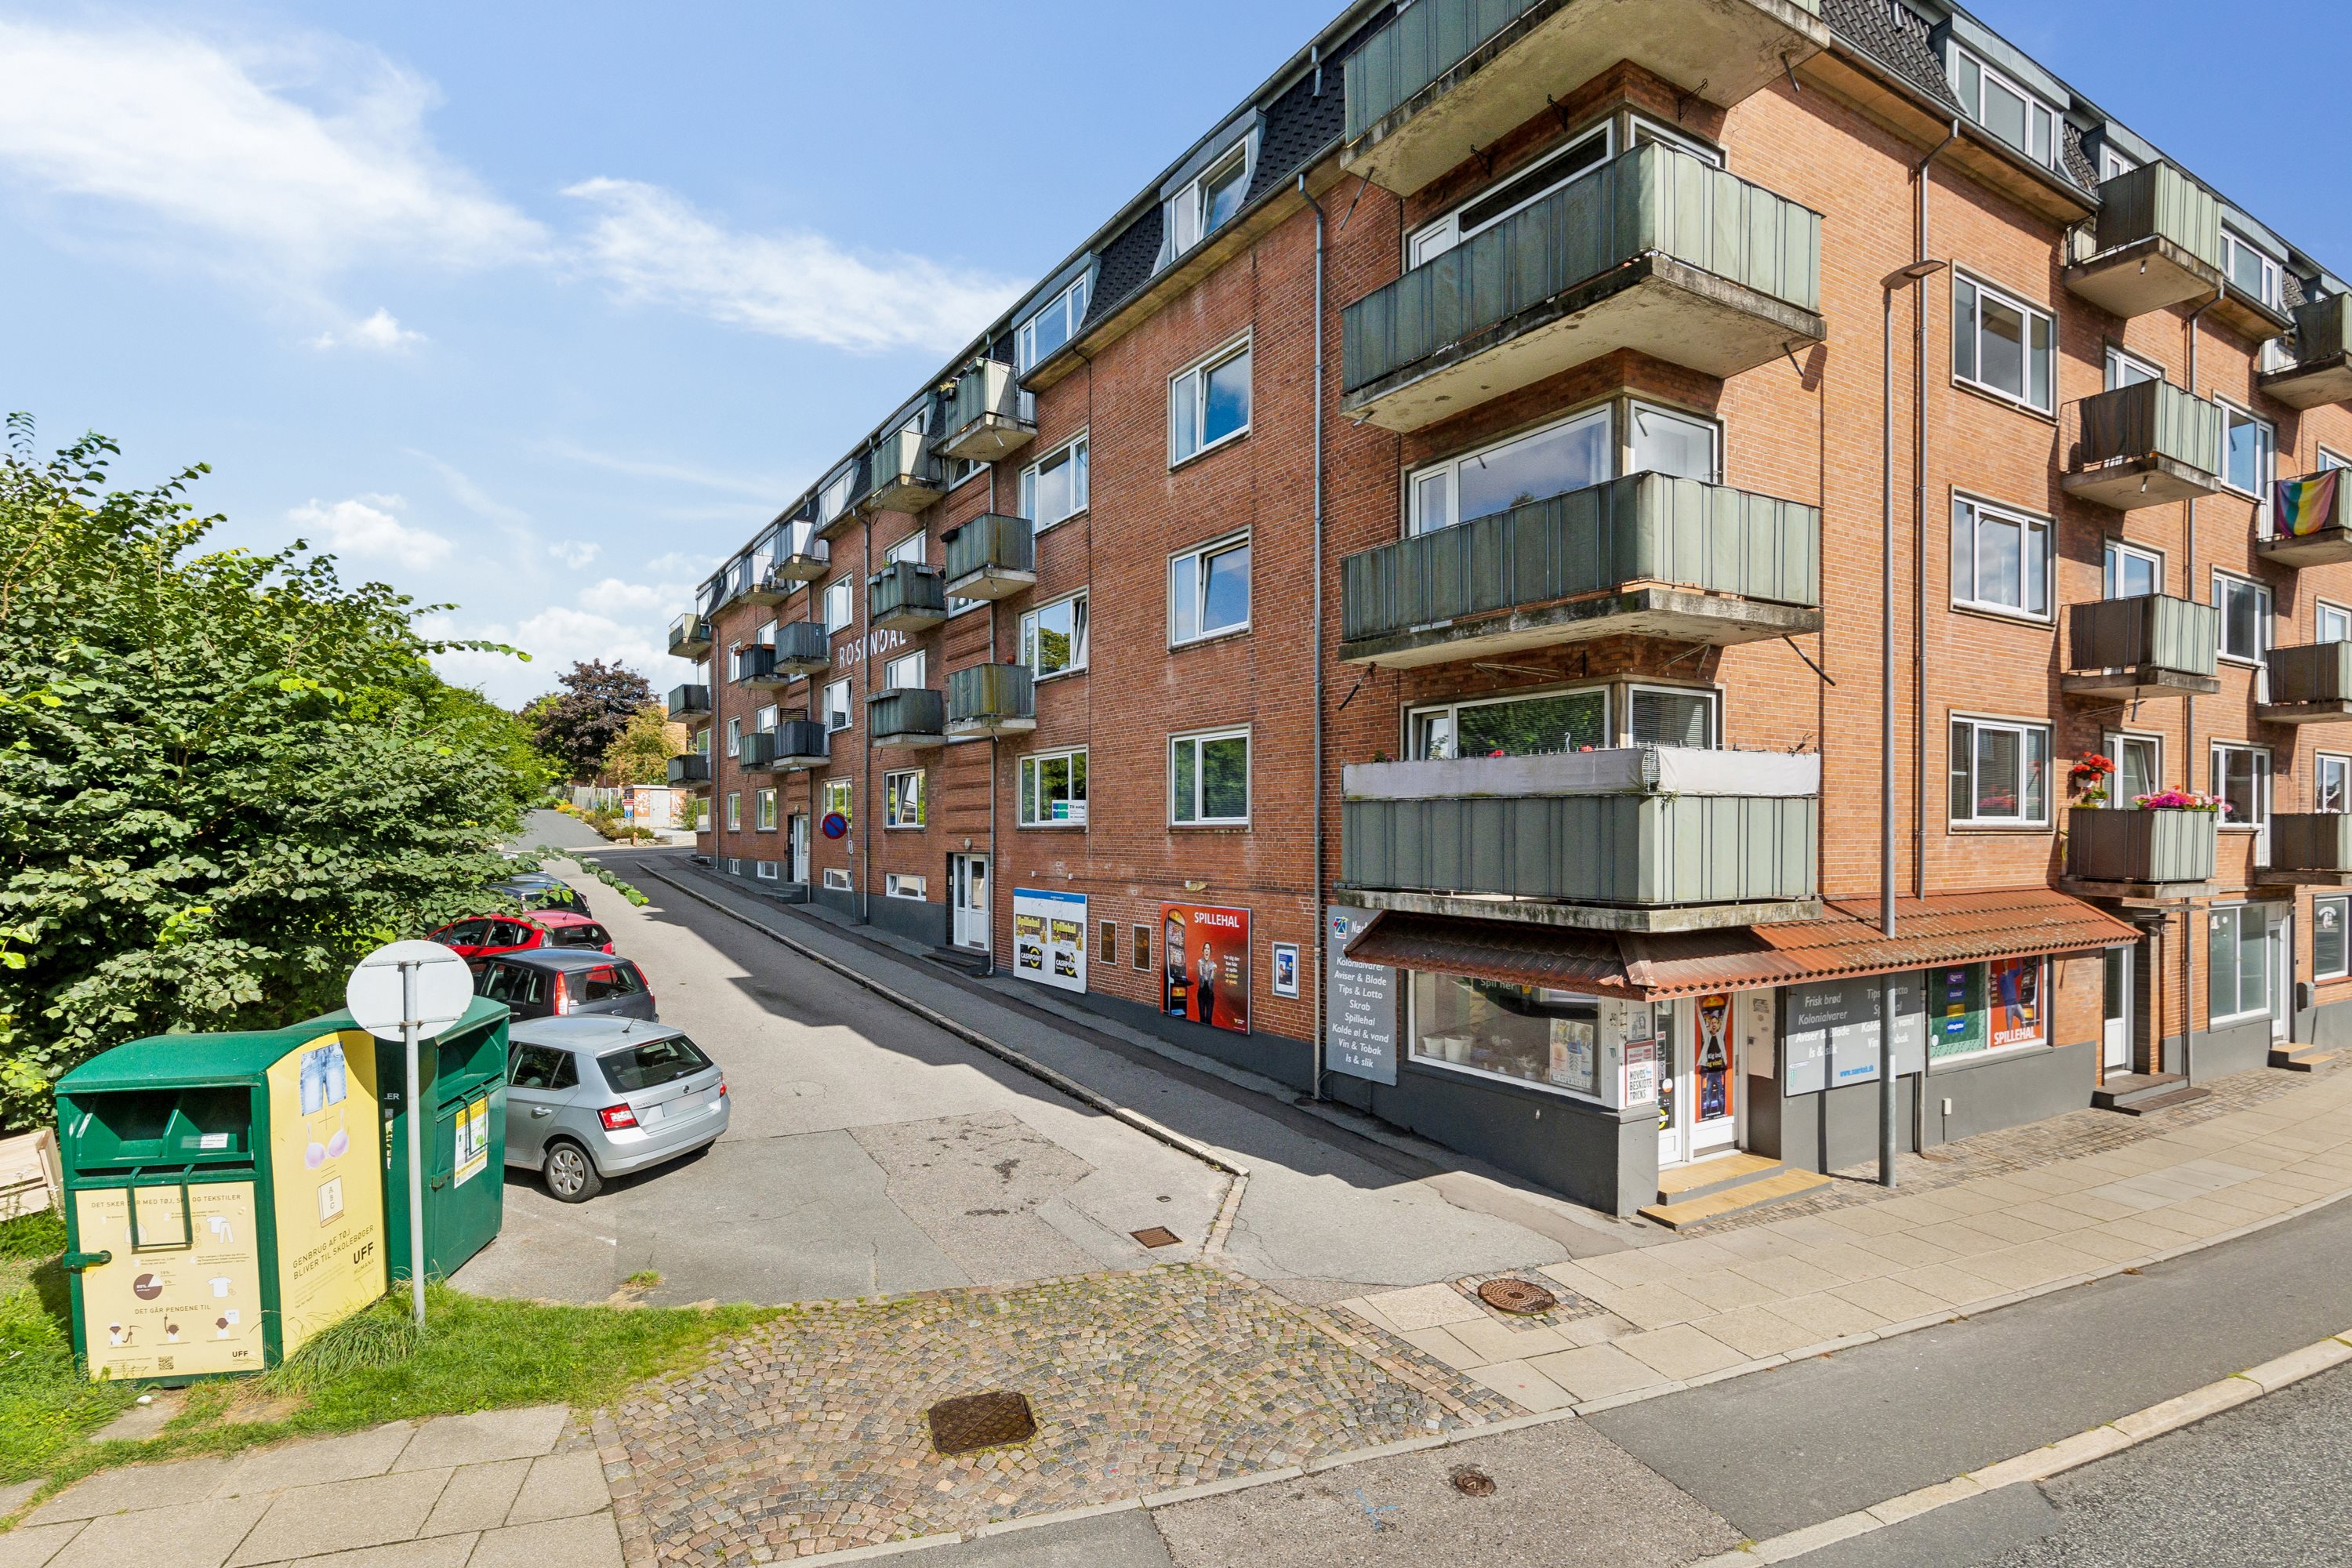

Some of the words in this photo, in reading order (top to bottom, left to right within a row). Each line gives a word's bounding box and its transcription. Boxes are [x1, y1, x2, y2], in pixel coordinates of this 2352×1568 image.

[1052, 920, 1076, 935] Spillehal
[1194, 912, 1240, 928] SPILLEHAL
[1021, 953, 1041, 962] CASHPOINT
[1337, 957, 1385, 971] Kolonialvarer
[1334, 970, 1356, 981] Aviser
[1356, 973, 1363, 982] &
[1365, 975, 1387, 986] Blade
[1480, 978, 1497, 989] Spil
[1500, 981, 1515, 989] her
[1338, 984, 1352, 996] Tips
[1354, 986, 1360, 996] &
[1363, 988, 1383, 1000] Lotto
[1867, 989, 1881, 1001] Tips
[1895, 986, 1908, 996] otto
[1349, 999, 1370, 1011] Skrab
[1805, 994, 1822, 1007] Frisk
[1824, 993, 1842, 1005] brød
[1345, 1012, 1376, 1026] Spillehal
[1798, 1011, 1848, 1025] Kolonialvarer
[1898, 1016, 1915, 1027] vand
[1332, 1023, 1352, 1036] Kolde
[1353, 1029, 1361, 1037] øl
[1363, 1029, 1369, 1039] &
[1370, 1033, 1389, 1044] vand
[1795, 1032, 1819, 1044] Aviser
[1820, 1028, 1826, 1039] &
[1829, 1025, 1850, 1038] Blade
[1994, 1026, 2035, 1045] SPILLEHAL
[1338, 1038, 1349, 1048] Vin
[1351, 1041, 1358, 1051] &
[1359, 1043, 1382, 1056] Tobak
[1867, 1037, 1879, 1048] Vin
[1809, 1047, 1816, 1058] Is
[1817, 1046, 1825, 1057] &
[1825, 1044, 1838, 1055] slik
[1345, 1054, 1352, 1062] Is
[1353, 1055, 1359, 1065] &
[1361, 1058, 1374, 1069] slik
[292, 1243, 328, 1269] GENBRUG
[328, 1236, 337, 1247] AF
[339, 1228, 350, 1241] TØJ
[293, 1258, 319, 1280] BLIVER
[321, 1254, 332, 1265] TIL
[333, 1225, 374, 1256] SKOLEBØGER
[354, 1242, 374, 1265] UFF
